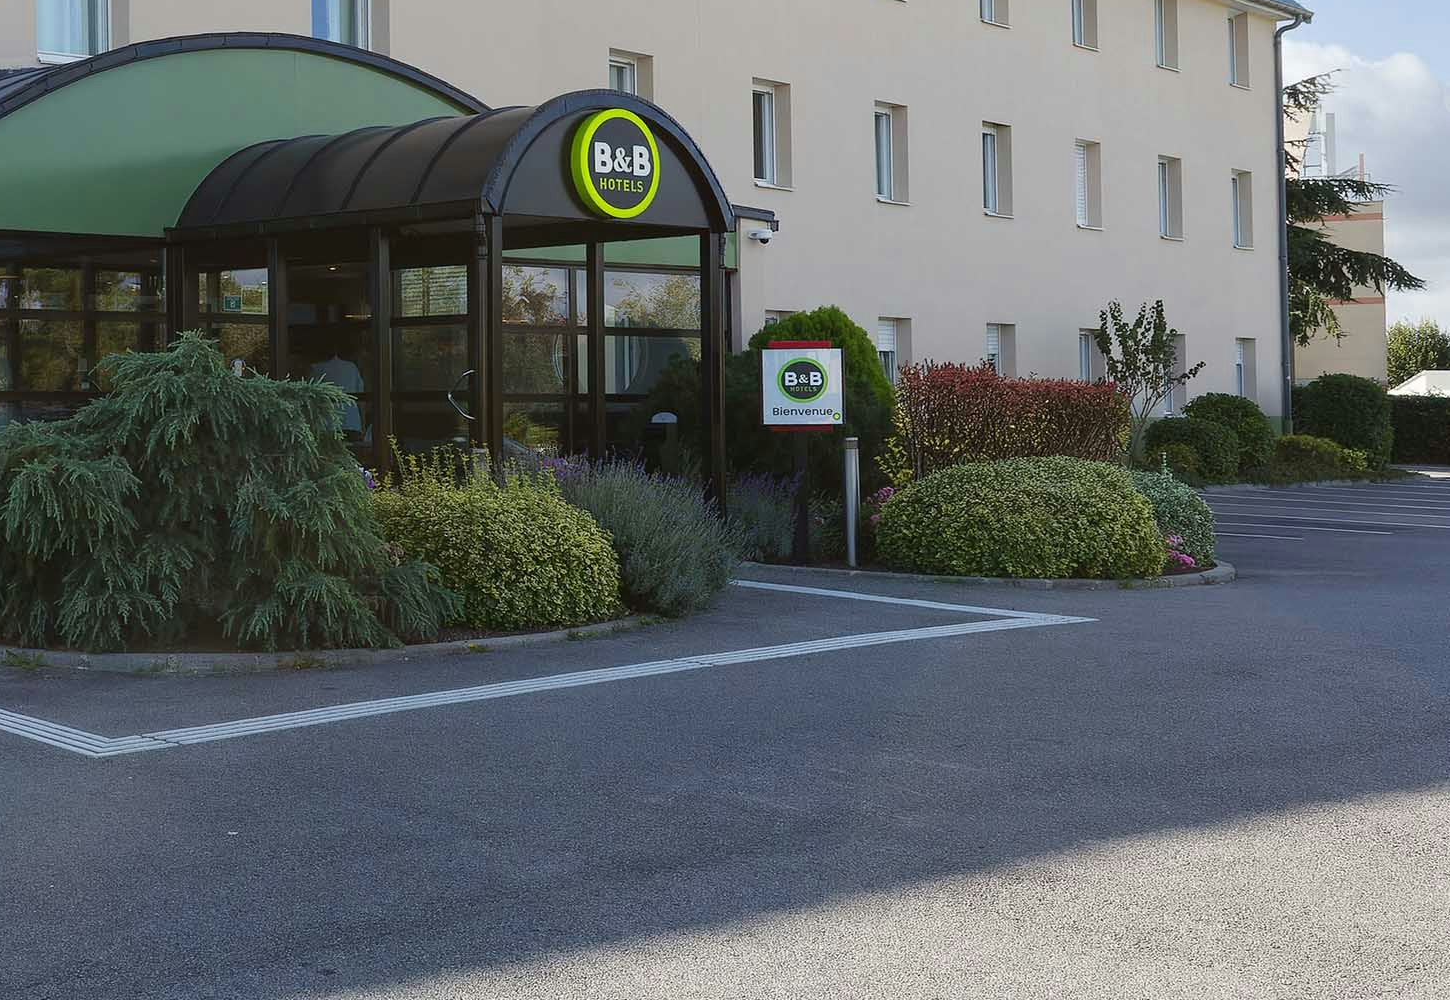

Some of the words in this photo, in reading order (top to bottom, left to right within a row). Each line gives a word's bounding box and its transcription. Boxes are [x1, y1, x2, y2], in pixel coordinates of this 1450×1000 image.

[594, 141, 651, 177] B&B
[599, 177, 644, 193] HOTELS
[784, 371, 823, 386] B&B
